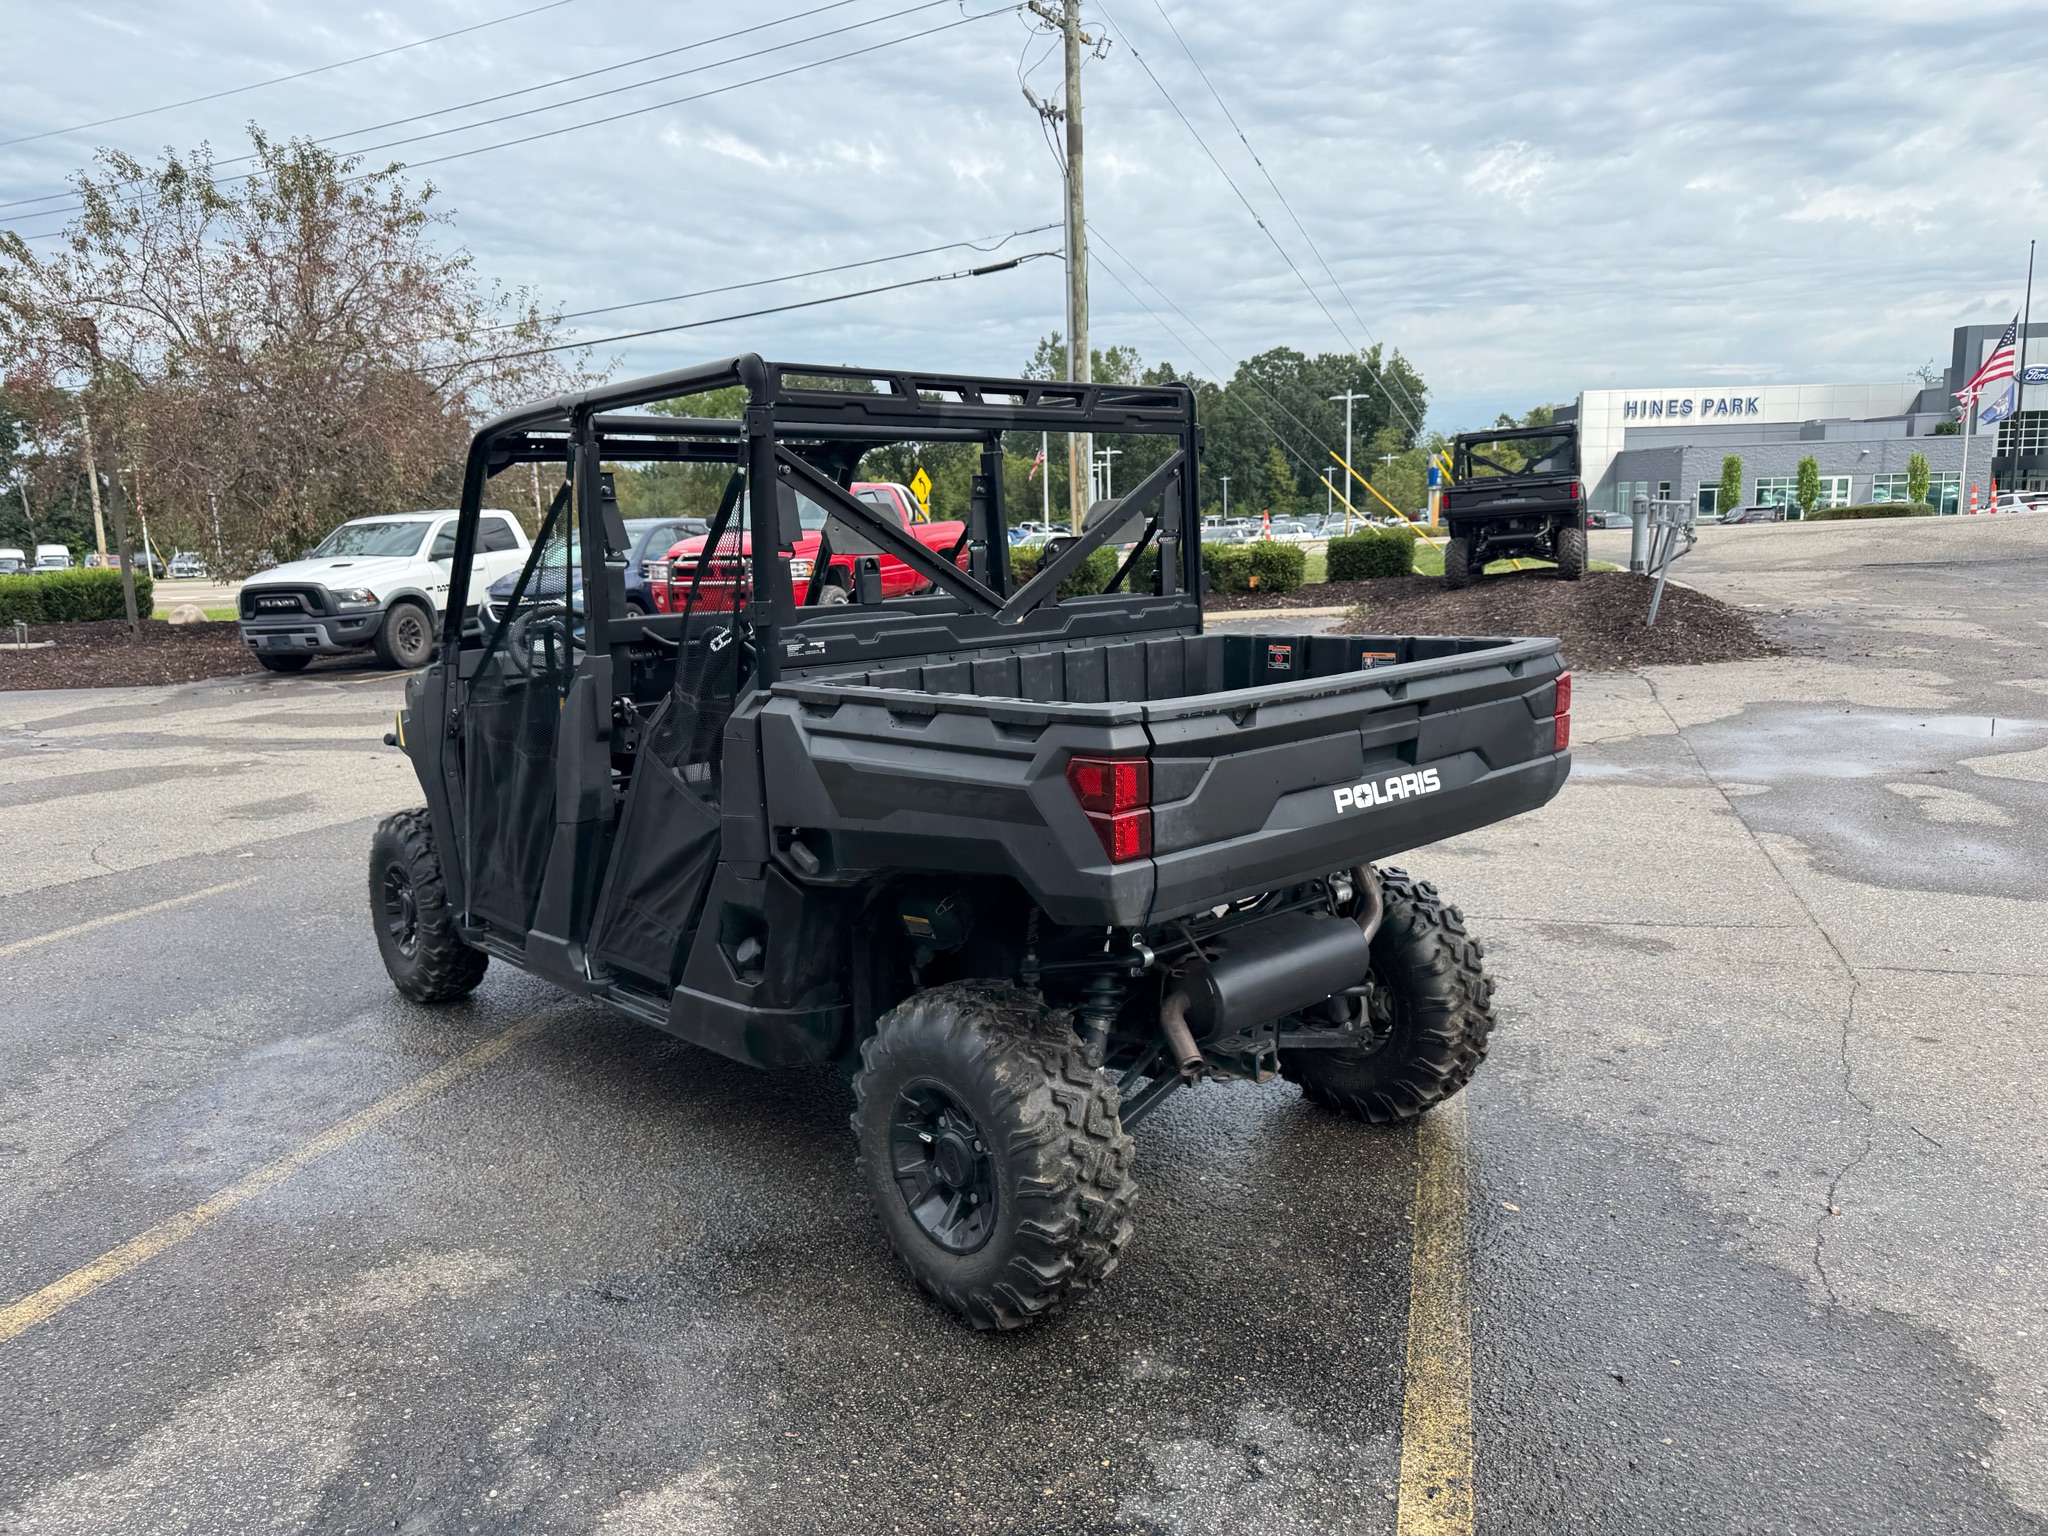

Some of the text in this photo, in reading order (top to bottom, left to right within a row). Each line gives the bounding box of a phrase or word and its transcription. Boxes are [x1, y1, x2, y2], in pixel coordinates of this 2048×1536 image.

[1624, 397, 1759, 418] HINES PARK
[1333, 768, 1440, 813] POLARIS
